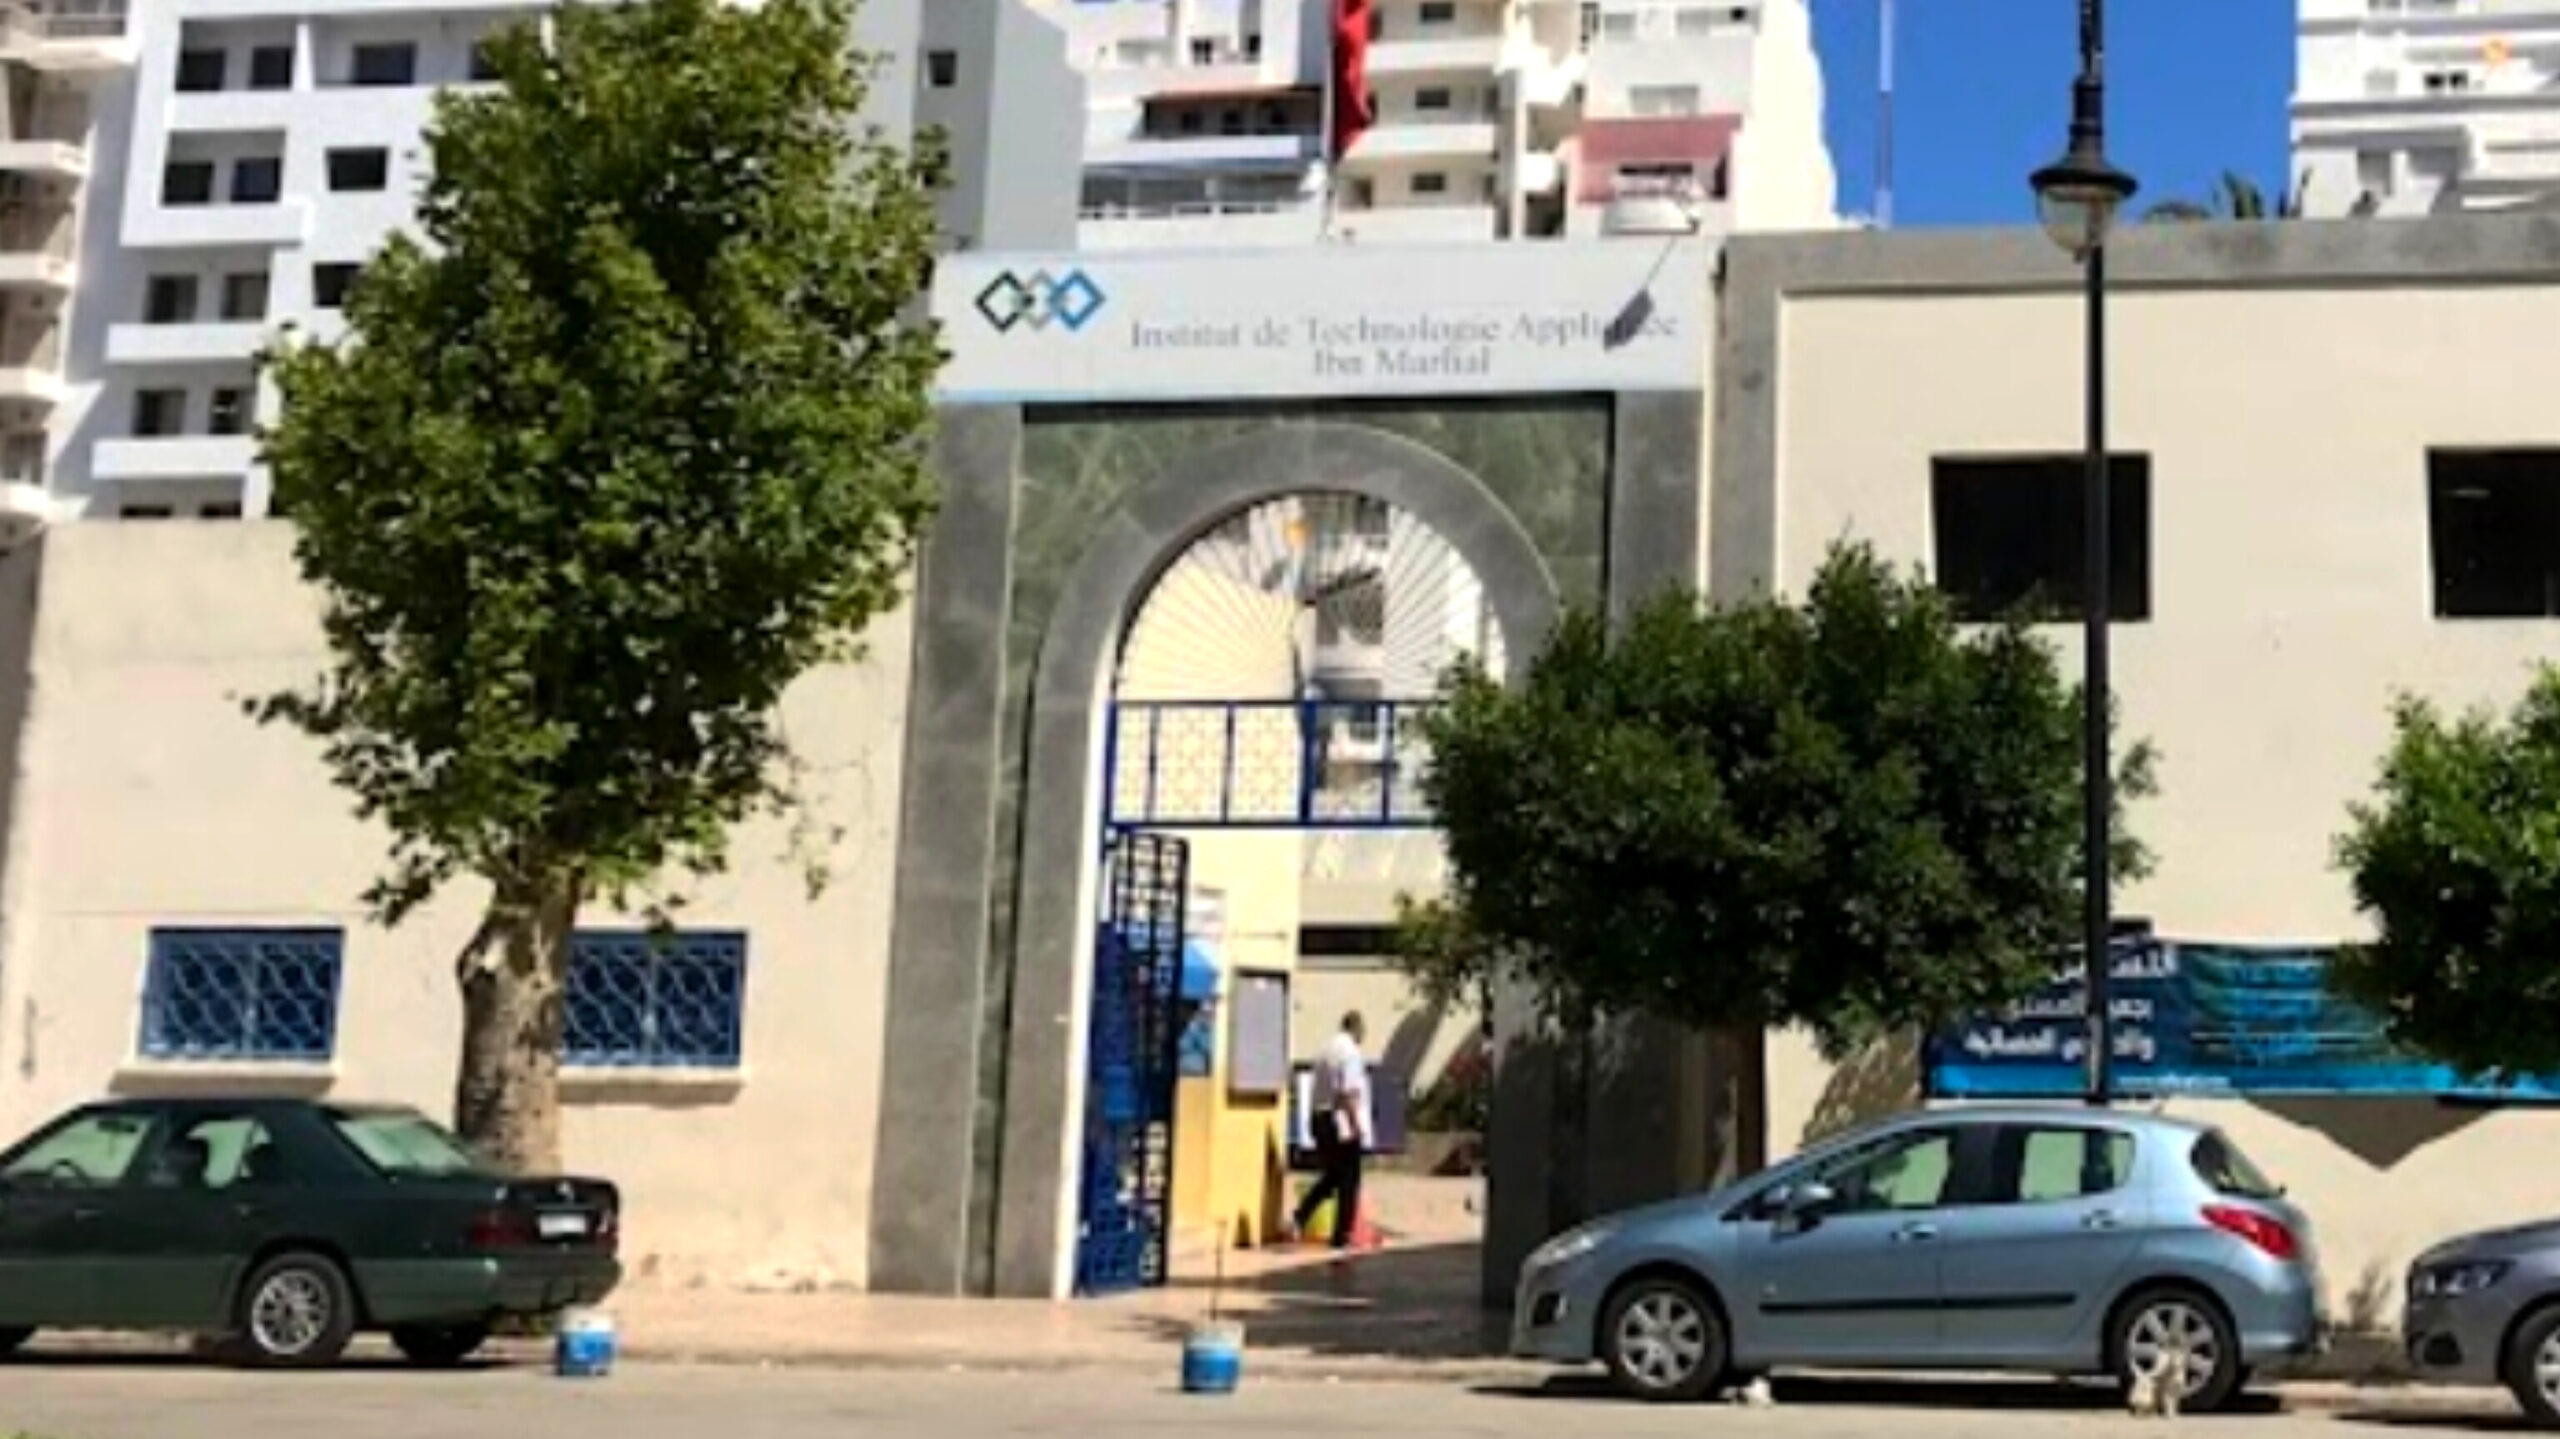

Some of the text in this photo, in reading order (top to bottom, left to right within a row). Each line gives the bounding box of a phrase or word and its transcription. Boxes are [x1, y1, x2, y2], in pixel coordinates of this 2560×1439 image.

[1131, 318, 1240, 348] Institut
[1253, 315, 1289, 347] de
[1303, 313, 1499, 346] Technologie
[1314, 348, 1362, 375] Ibn
